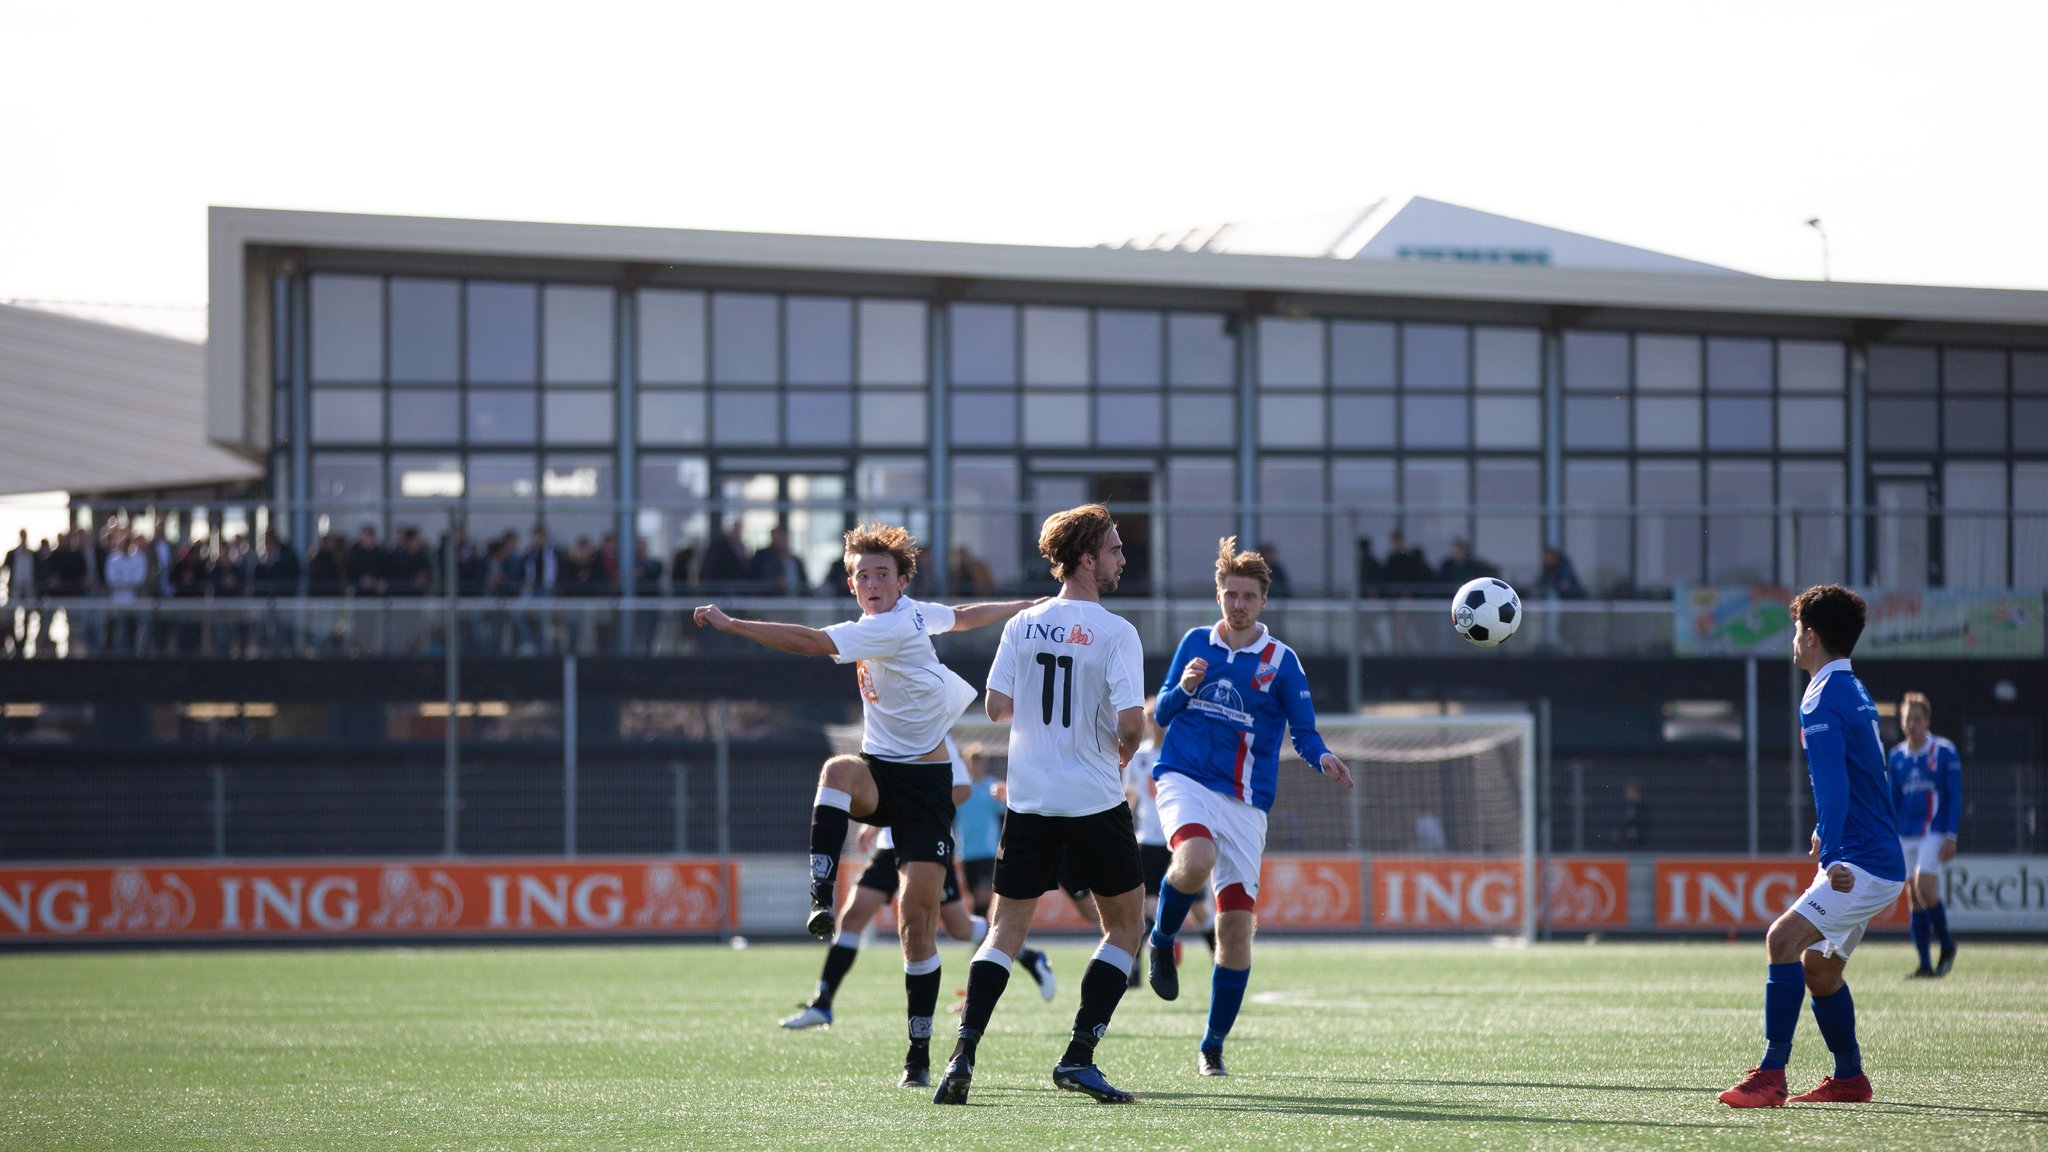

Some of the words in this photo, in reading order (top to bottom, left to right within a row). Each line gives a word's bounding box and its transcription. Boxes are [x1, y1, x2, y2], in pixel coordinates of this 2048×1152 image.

[1025, 623, 1066, 643] ING
[1036, 652, 1074, 728] 11
[219, 875, 361, 931] ING
[487, 873, 626, 929] ING
[1384, 870, 1517, 924] ING
[1665, 871, 1800, 923] ING
[1807, 900, 1827, 916] JAKO
